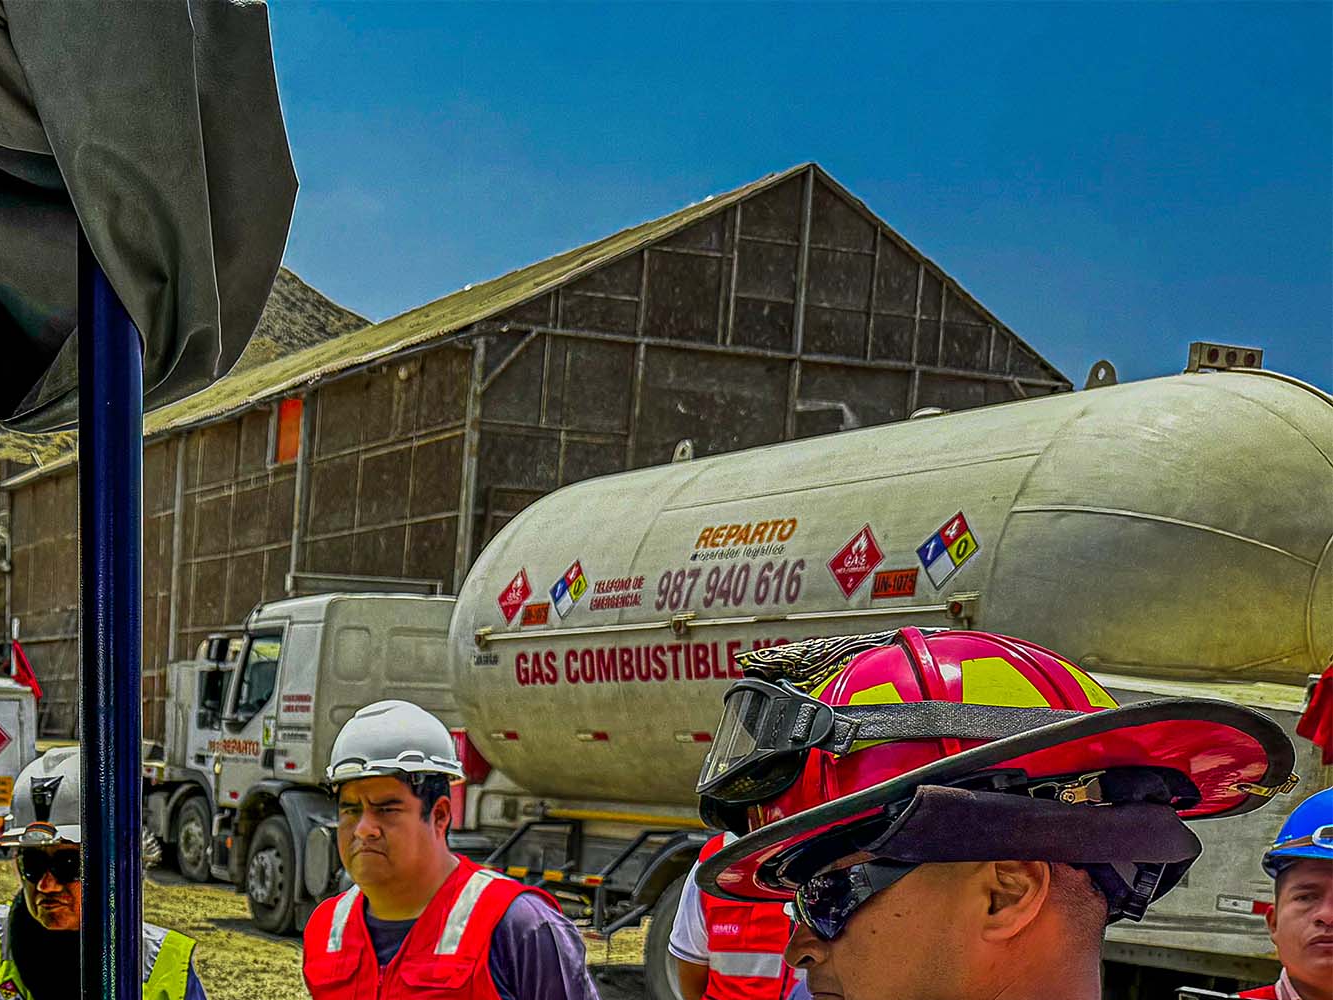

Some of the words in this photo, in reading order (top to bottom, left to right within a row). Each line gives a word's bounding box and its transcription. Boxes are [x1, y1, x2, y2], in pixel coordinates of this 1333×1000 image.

[695, 517, 798, 549] REPARTO
[945, 518, 960, 539] 4
[843, 553, 867, 568] GAS
[956, 537, 969, 560] 0
[654, 567, 702, 612] 987
[703, 561, 750, 607] 940
[754, 557, 806, 605] 616
[515, 649, 559, 687] GAS
[564, 637, 745, 686] COMBUSTIBLE
